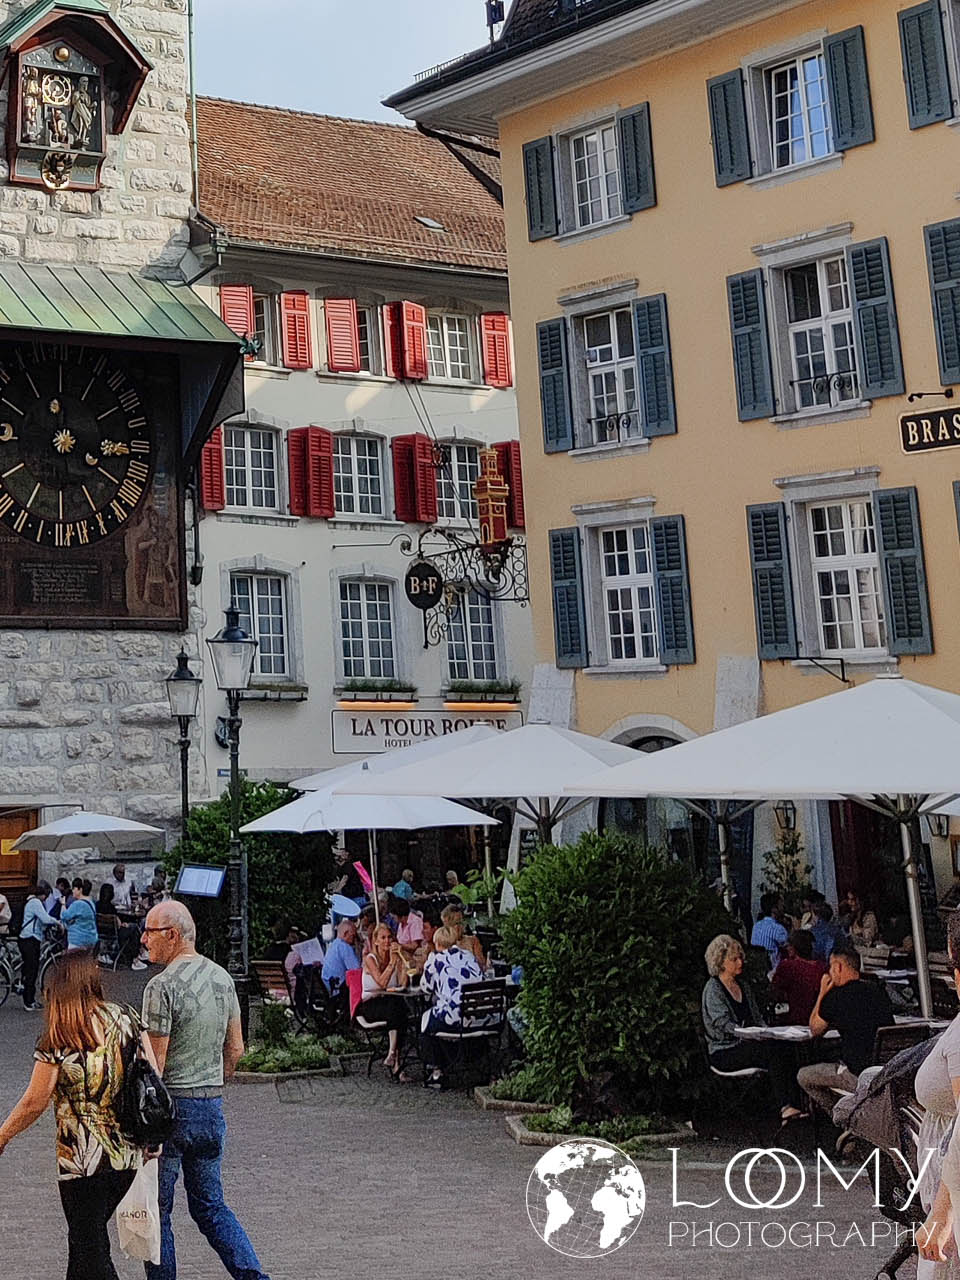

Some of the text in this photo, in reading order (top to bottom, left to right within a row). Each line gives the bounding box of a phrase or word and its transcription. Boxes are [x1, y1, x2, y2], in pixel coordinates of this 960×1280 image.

[906, 413, 960, 446] BRAS
[351, 718, 507, 737] LA TOUR ROE
